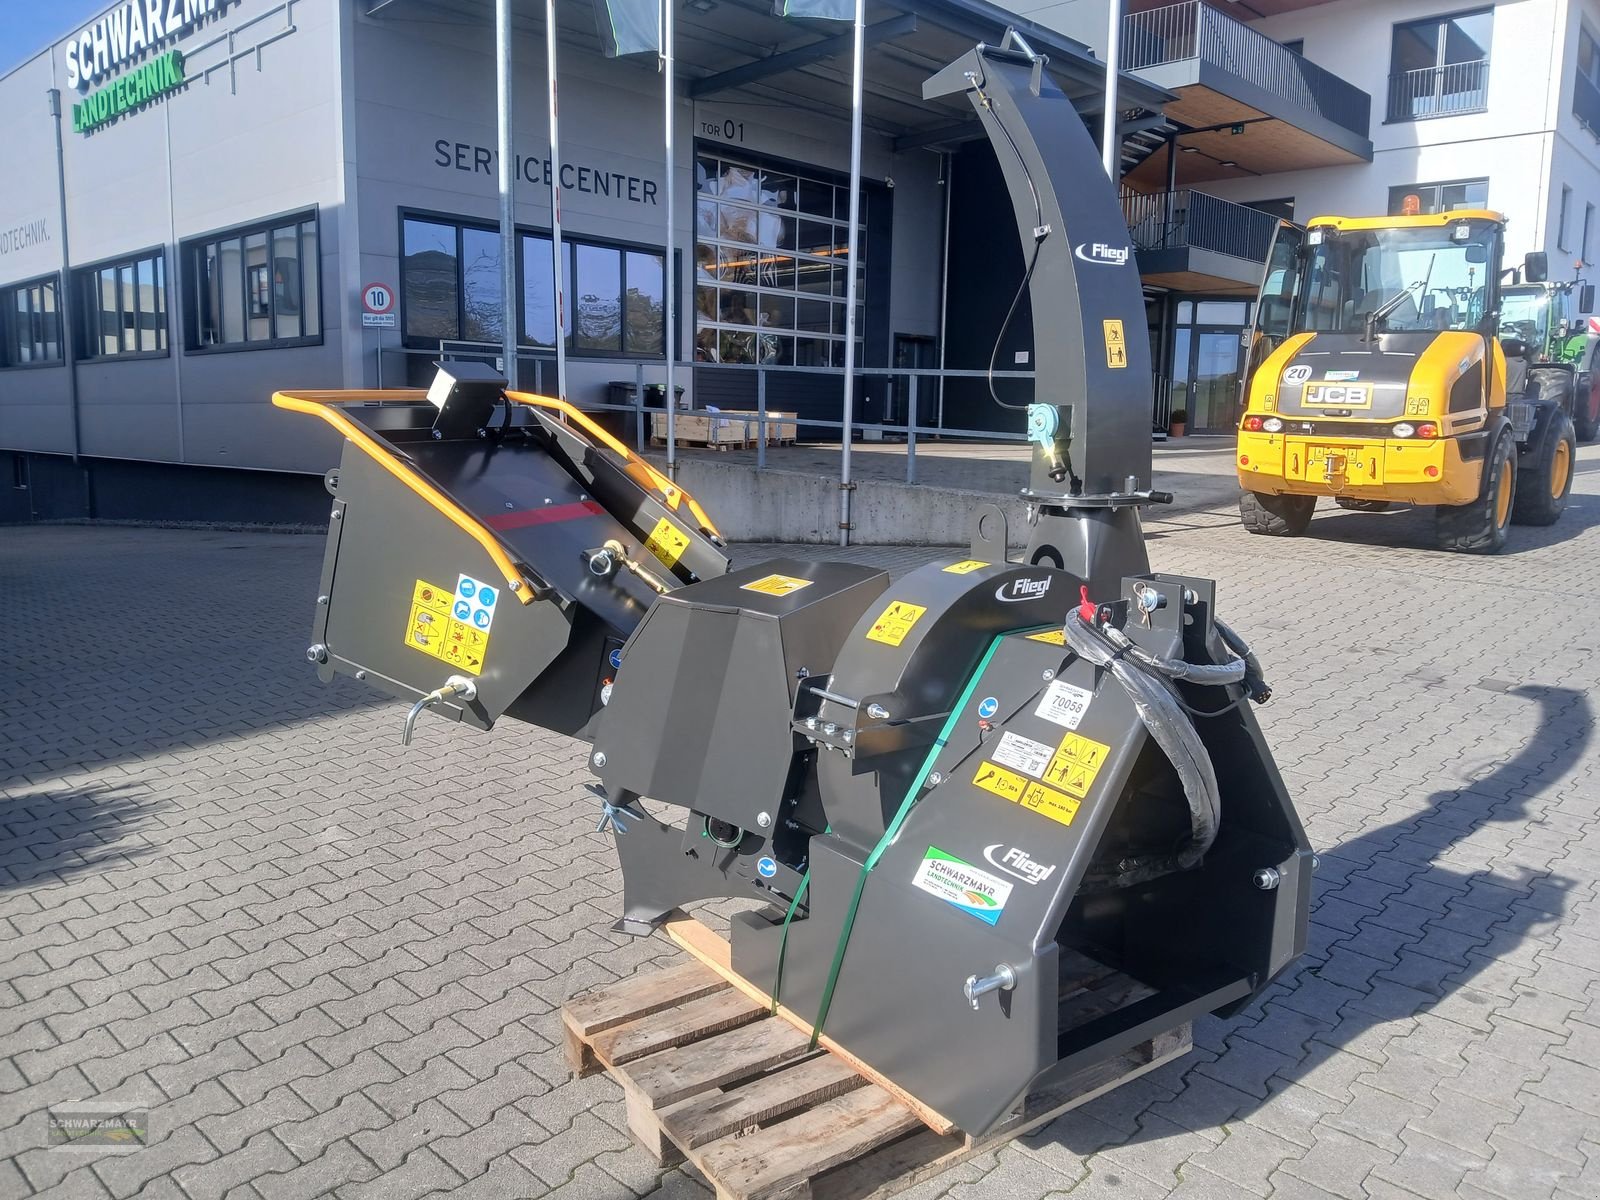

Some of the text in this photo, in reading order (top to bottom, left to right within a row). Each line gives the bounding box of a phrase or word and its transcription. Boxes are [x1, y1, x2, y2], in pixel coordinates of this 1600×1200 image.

[65, 0, 217, 89] SCHWARZ
[73, 50, 183, 133] LANDTECHNIK
[701, 119, 744, 142] TOR 01
[434, 139, 657, 205] SERICECENTER
[1092, 243, 1129, 262] Fliegl
[371, 291, 384, 306] 10
[1287, 368, 1308, 379] 20
[1307, 385, 1368, 404] JCB
[1012, 575, 1052, 596] Fliegl
[1052, 694, 1084, 714] 70058
[1002, 847, 1057, 882] Fliegl
[927, 870, 964, 893] LANDTECHNIK
[929, 860, 996, 897] SCHWARZMAYR
